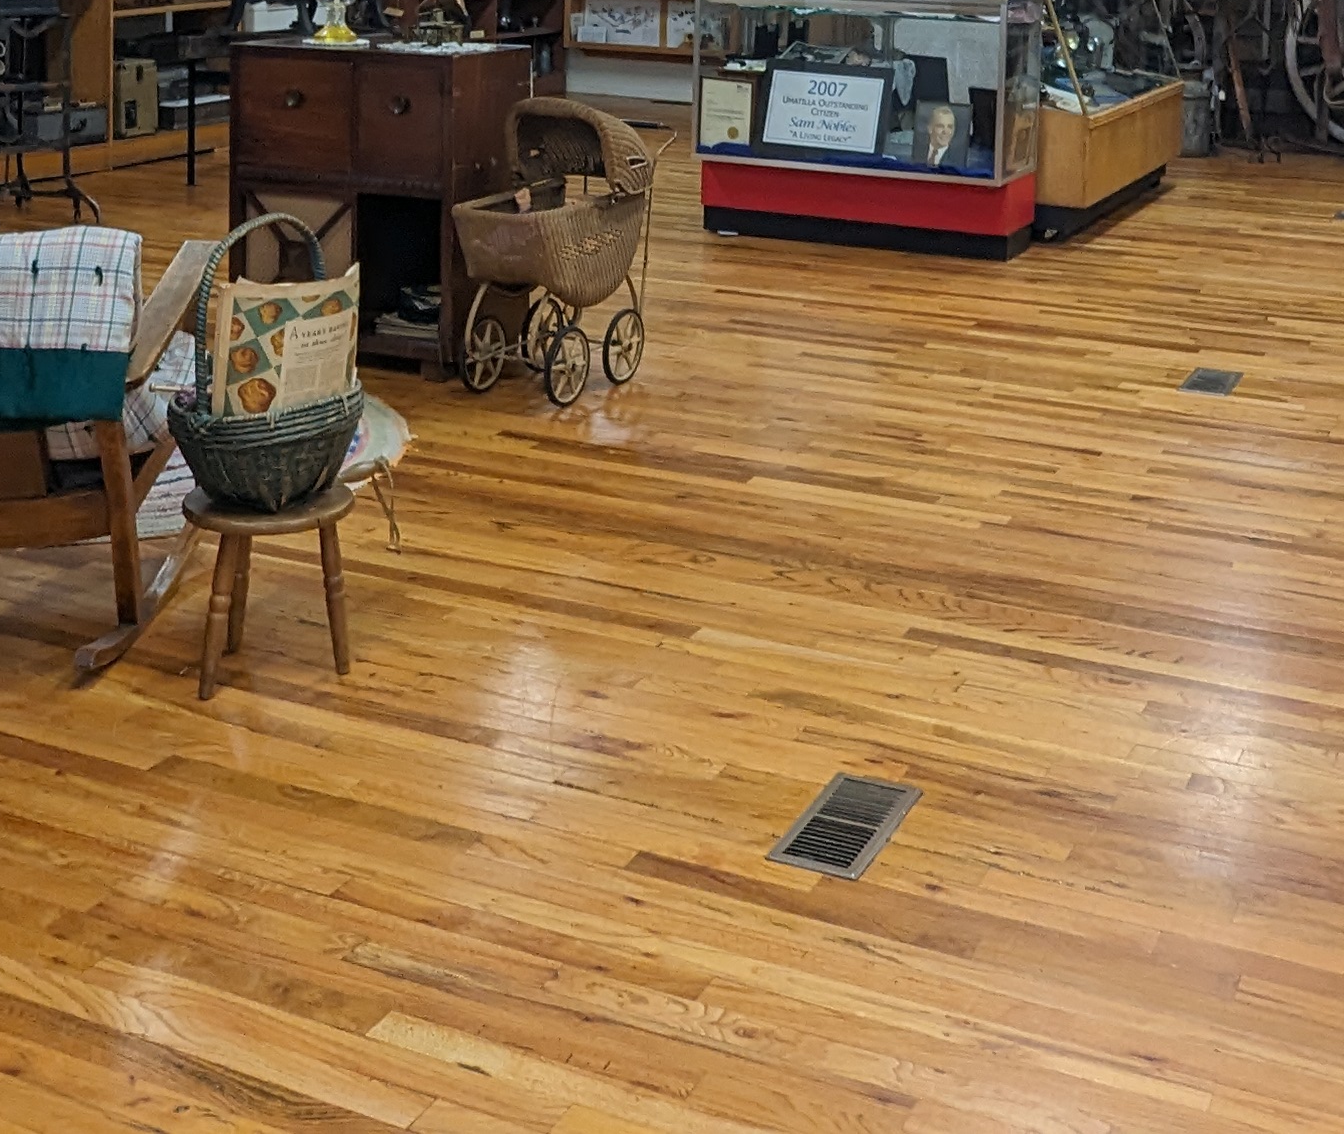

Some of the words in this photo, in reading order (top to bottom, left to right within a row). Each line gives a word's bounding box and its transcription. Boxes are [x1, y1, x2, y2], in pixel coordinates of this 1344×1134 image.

[808, 79, 848, 97] 2007
[788, 116, 815, 129] Sam
[816, 118, 858, 133] Nobles
